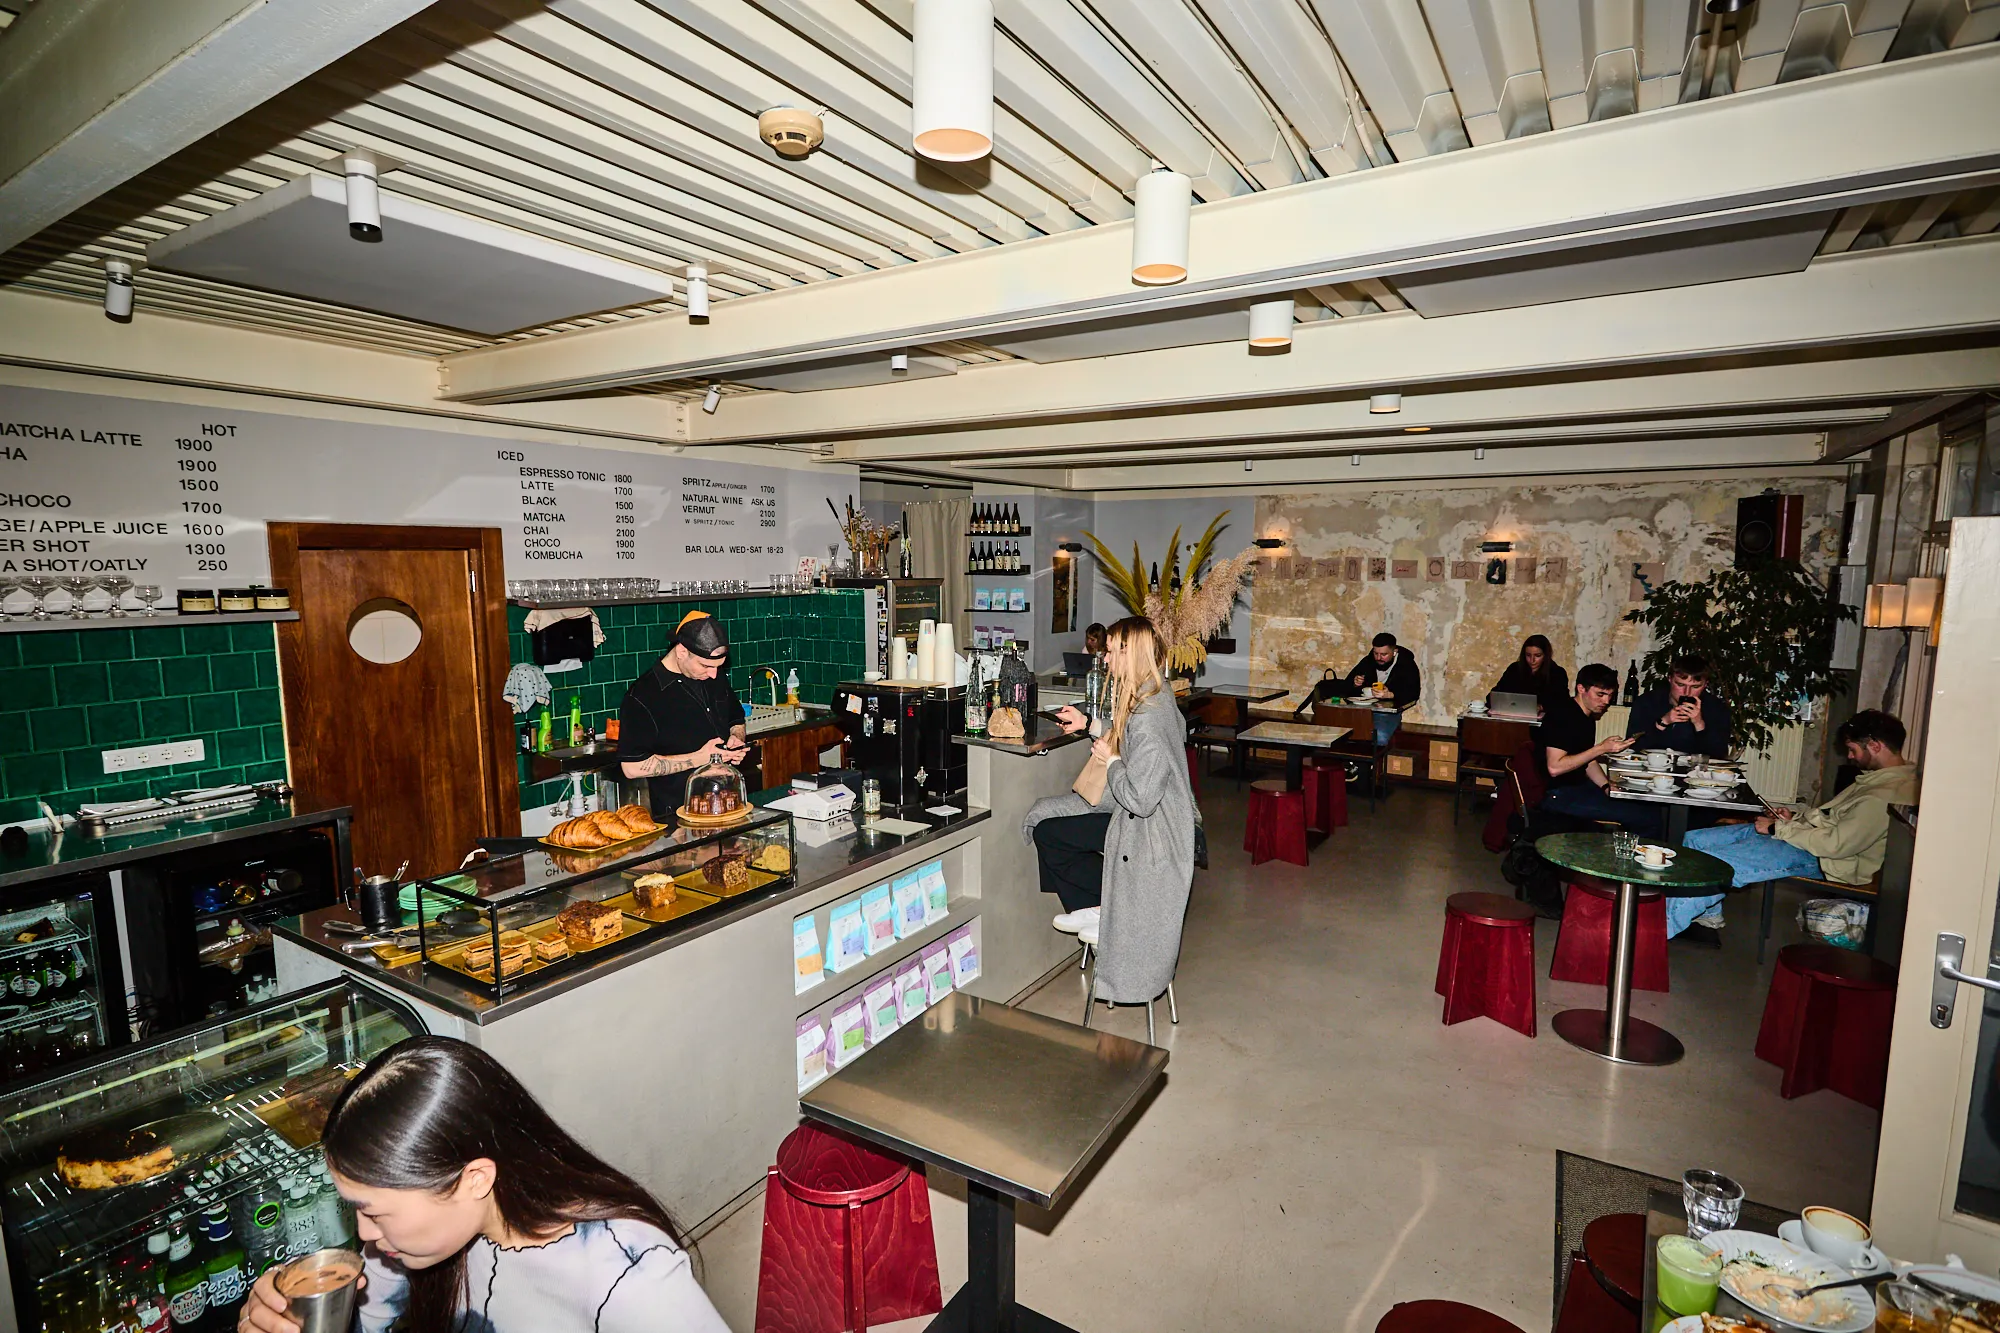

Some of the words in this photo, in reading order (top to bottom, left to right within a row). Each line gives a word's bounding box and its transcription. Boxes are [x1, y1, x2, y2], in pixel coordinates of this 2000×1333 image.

[202, 424, 238, 437] HOT
[0, 423, 75, 442] ATCHA
[81, 430, 143, 447] LATTE
[175, 439, 213, 452] 1900
[498, 451, 525, 462] ICED
[178, 460, 217, 473] 1900
[520, 467, 575, 480] ESPRESSO
[577, 471, 606, 482] TONIC
[614, 475, 633, 484] 1800
[179, 479, 219, 492] 1500
[521, 481, 555, 492] LATTE
[615, 487, 633, 496] 1700
[683, 478, 711, 488] SPRITZ
[761, 486, 775, 494] 1700
[522, 496, 557, 506] BLACK
[616, 502, 634, 510] 1500
[683, 494, 720, 504] NATURAL
[722, 497, 743, 505] WINE
[751, 499, 765, 507] ASK
[182, 502, 222, 515] 1700
[683, 506, 716, 515] VERMUT
[760, 510, 776, 518] 2100
[524, 513, 566, 523] MATCHA
[616, 515, 635, 524] 2150
[761, 520, 776, 528] 2900
[113, 522, 169, 535] JUICE
[184, 524, 224, 536] 1600
[524, 526, 549, 536] CHAI
[617, 529, 635, 538] 2100
[33, 540, 91, 553] SHOT
[186, 544, 226, 556] 1300
[525, 539, 561, 548] CHOCO
[616, 540, 635, 549] 1900
[686, 546, 702, 554] BAR
[705, 546, 725, 554] LOLA
[729, 546, 763, 554] WED-SAT
[526, 551, 583, 560] KOMBUCHA
[617, 552, 635, 560] 1700
[3, 560, 18, 573] A
[23, 559, 148, 572] SHOT/OATLY
[198, 560, 228, 572] 250
[289, 1216, 315, 1233] 383
[197, 1262, 255, 1295] Peroni
